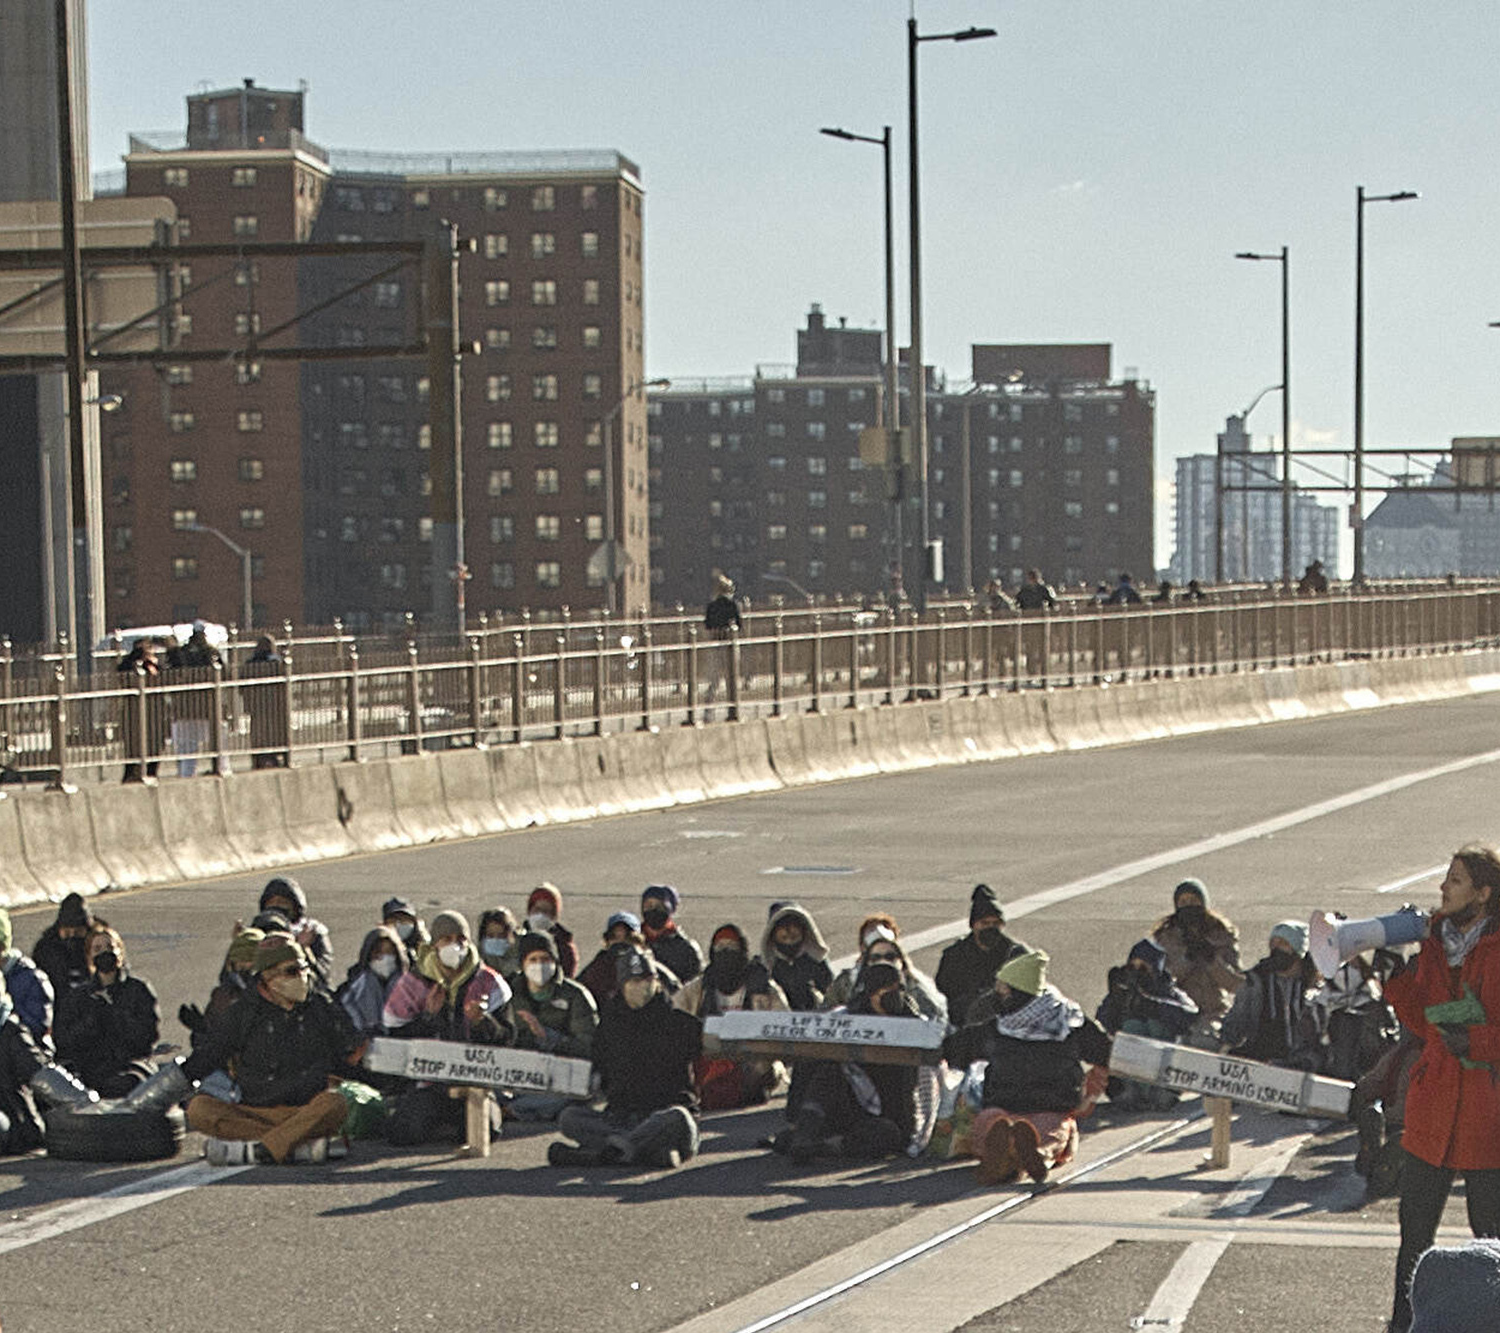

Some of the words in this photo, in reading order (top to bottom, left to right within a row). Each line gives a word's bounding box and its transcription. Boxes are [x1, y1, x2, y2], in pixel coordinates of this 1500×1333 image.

[792, 1017, 822, 1027] LIFT
[829, 1018, 853, 1028] THE
[816, 1028, 835, 1038] ON
[841, 1028, 885, 1040] GAZA
[465, 1049, 496, 1066] USA
[411, 1058, 446, 1075] STOP
[450, 1064, 502, 1081] ARMING
[504, 1069, 545, 1086] ISRAEL
[1220, 1062, 1250, 1081] USA
[1164, 1066, 1198, 1085] STOP
[1201, 1076, 1255, 1097] ARMING
[1256, 1086, 1299, 1106] ISRAEL
